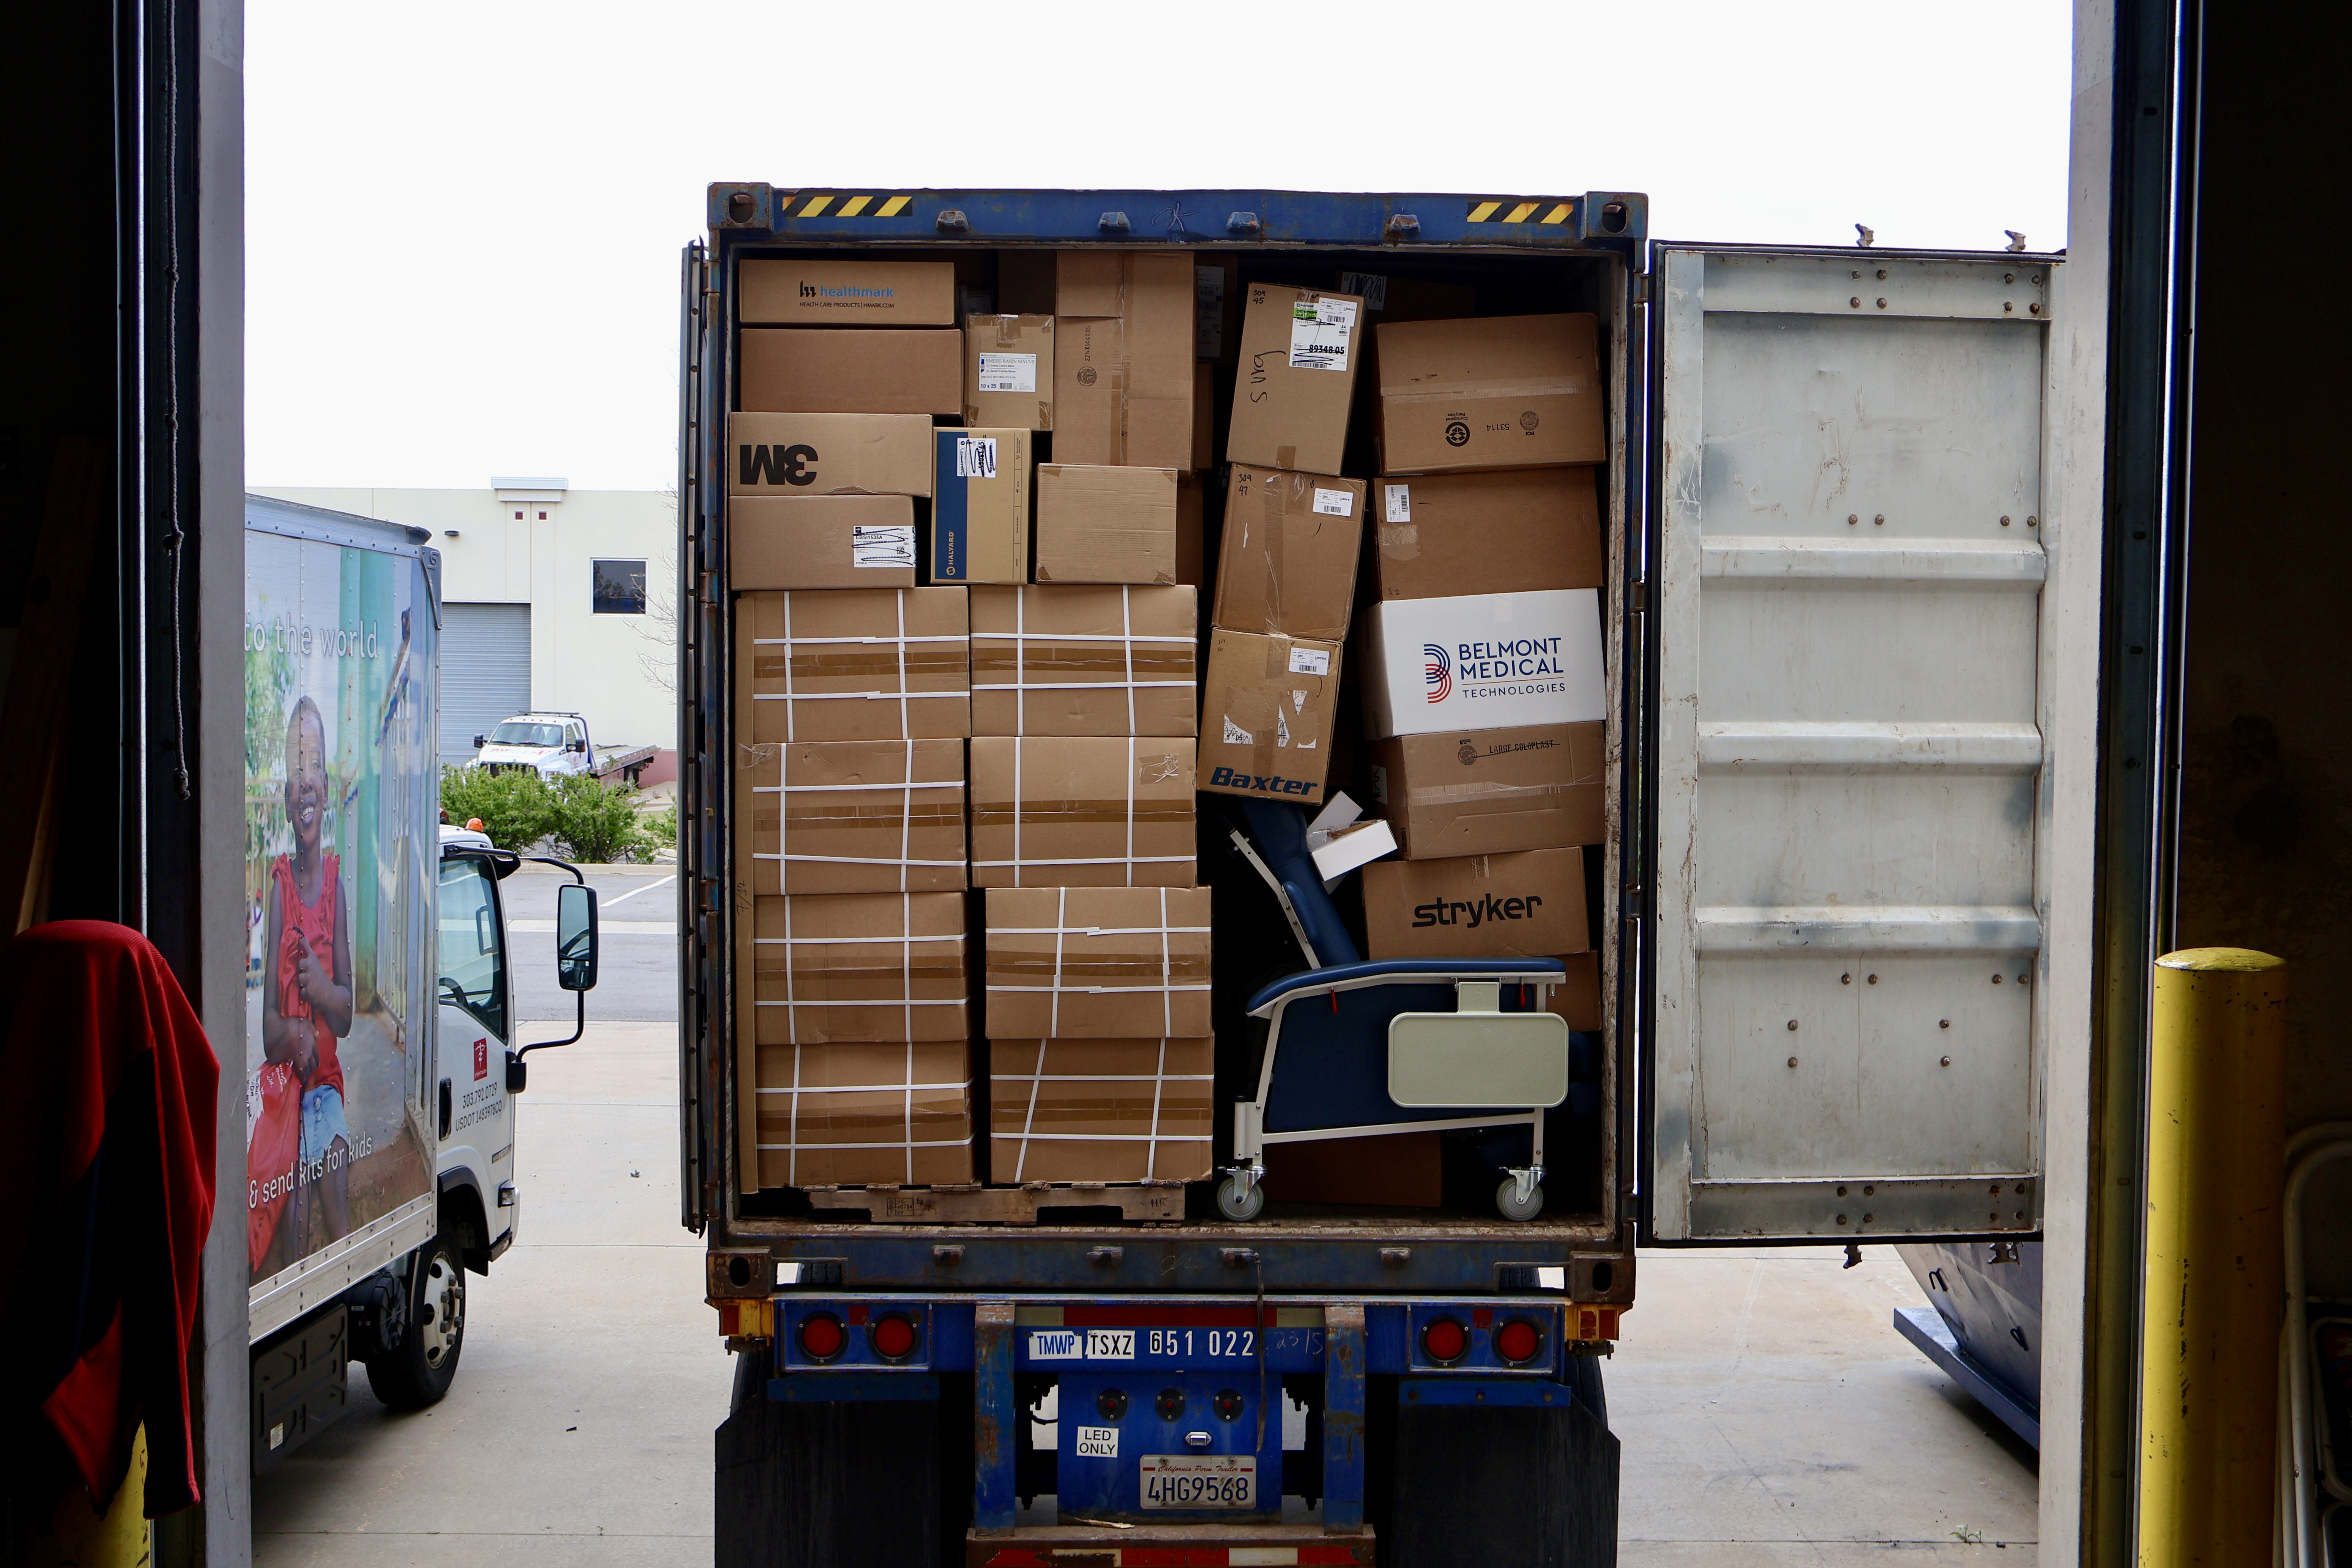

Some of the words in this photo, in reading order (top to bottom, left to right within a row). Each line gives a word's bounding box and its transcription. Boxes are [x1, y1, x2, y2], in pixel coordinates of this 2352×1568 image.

[821, 285, 894, 297] healthmark
[1309, 344, 1333, 354] 89348
[1335, 346, 1345, 355] 05
[740, 444, 818, 486] 3M
[1238, 474, 1251, 483] 309
[1239, 485, 1248, 496] 47
[244, 614, 266, 652] to
[275, 613, 312, 654] the
[321, 620, 378, 658] world
[1459, 637, 1562, 660] BELMONT
[1460, 657, 1564, 680] MEDICAL
[1462, 683, 1566, 698] TECHNOLOGIES
[1489, 744, 1511, 753] LARGE
[1515, 740, 1554, 751] COLOPLAST
[1210, 767, 1317, 796] Baxter
[1412, 893, 1543, 928] stryker
[463, 1082, 498, 1109] 303.792.0729
[456, 1112, 475, 1131] USDOT
[249, 1179, 258, 1209] &
[263, 1162, 294, 1203] send
[299, 1157, 323, 1186] kits
[327, 1145, 345, 1173] for
[348, 1131, 372, 1163] kids
[1037, 1335, 1075, 1355] TMWP
[1089, 1334, 1132, 1355] TSXZ
[1151, 1331, 1193, 1356] 651
[1209, 1331, 1254, 1356] 022
[1085, 1430, 1111, 1441] LED
[1079, 1443, 1115, 1455] ONLY
[1148, 1476, 1248, 1502] 4HG9568
